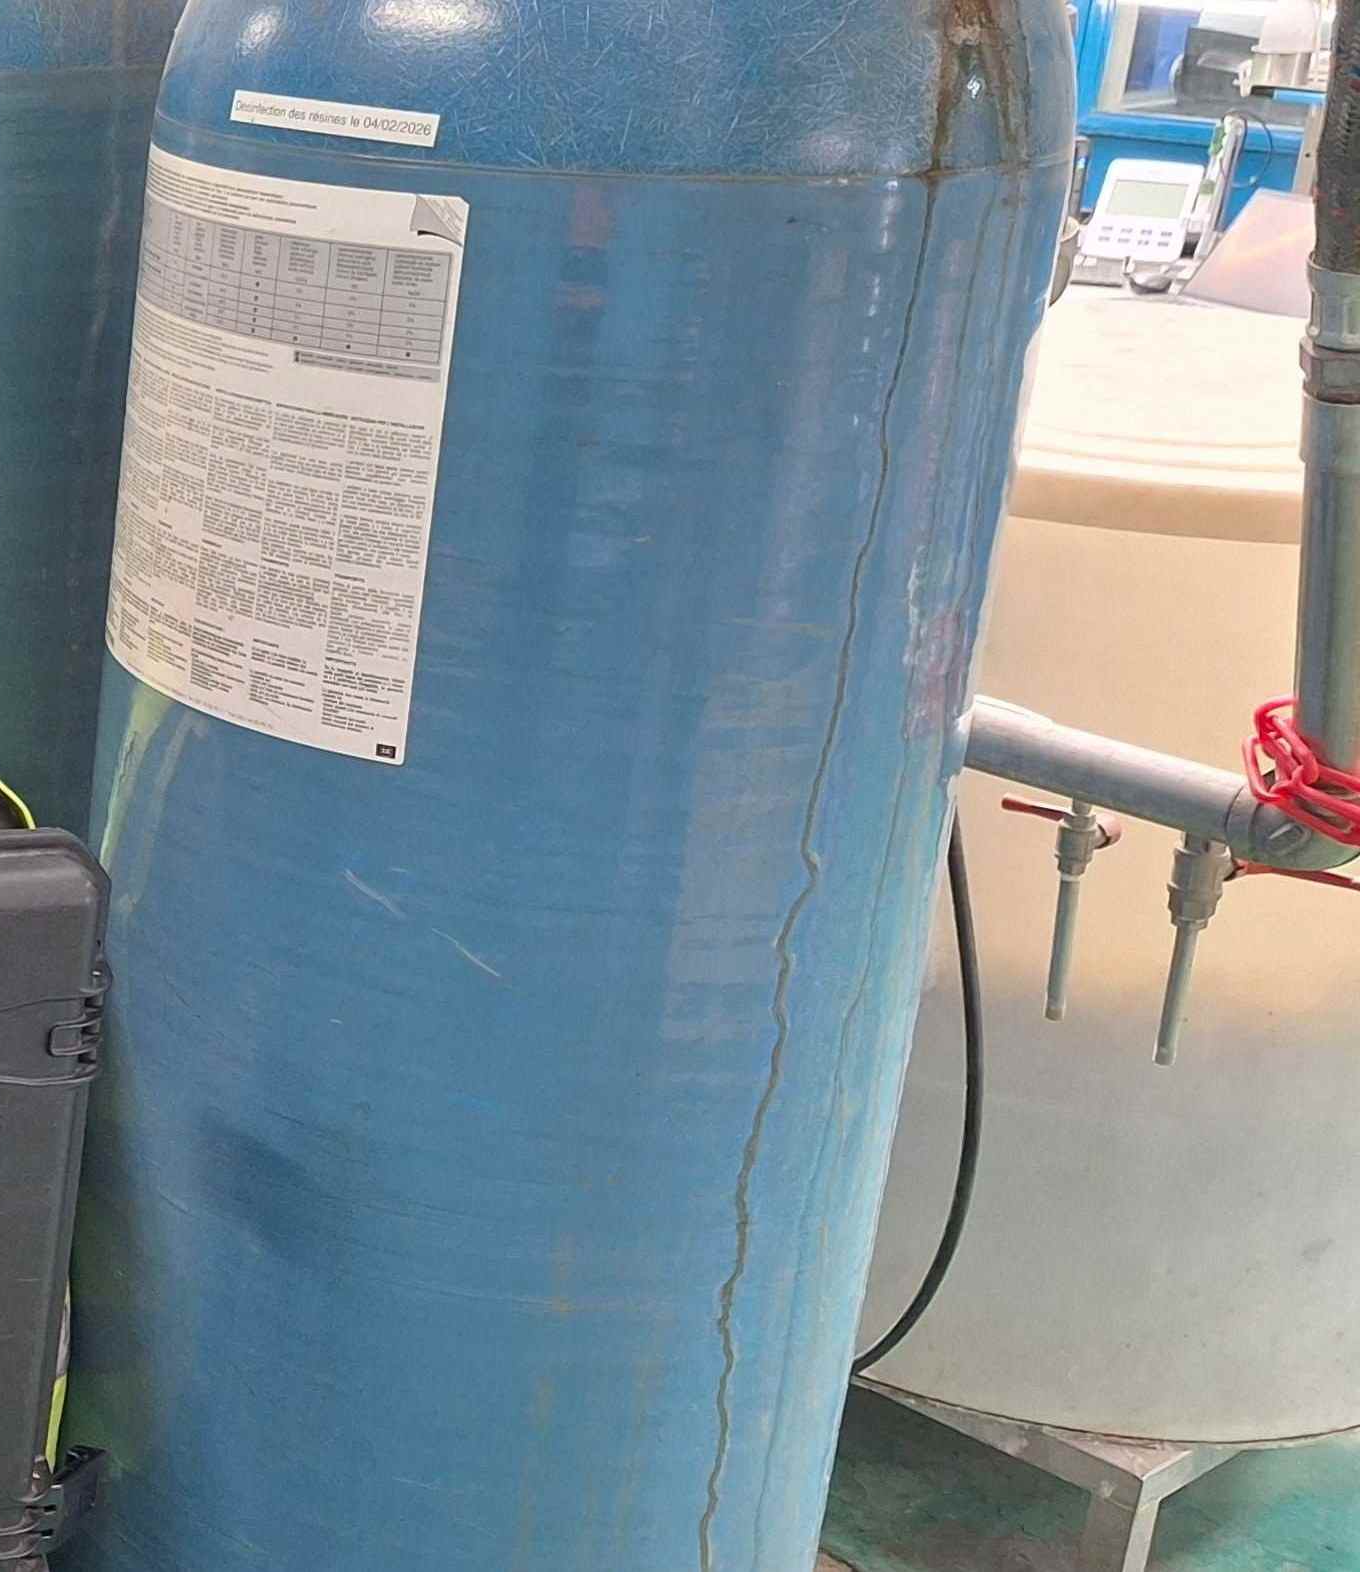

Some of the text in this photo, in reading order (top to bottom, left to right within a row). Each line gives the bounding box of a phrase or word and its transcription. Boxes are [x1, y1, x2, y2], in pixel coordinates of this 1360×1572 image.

[289, 109, 305, 121] des
[350, 115, 360, 127] le
[363, 117, 431, 136] 04/02/2026
